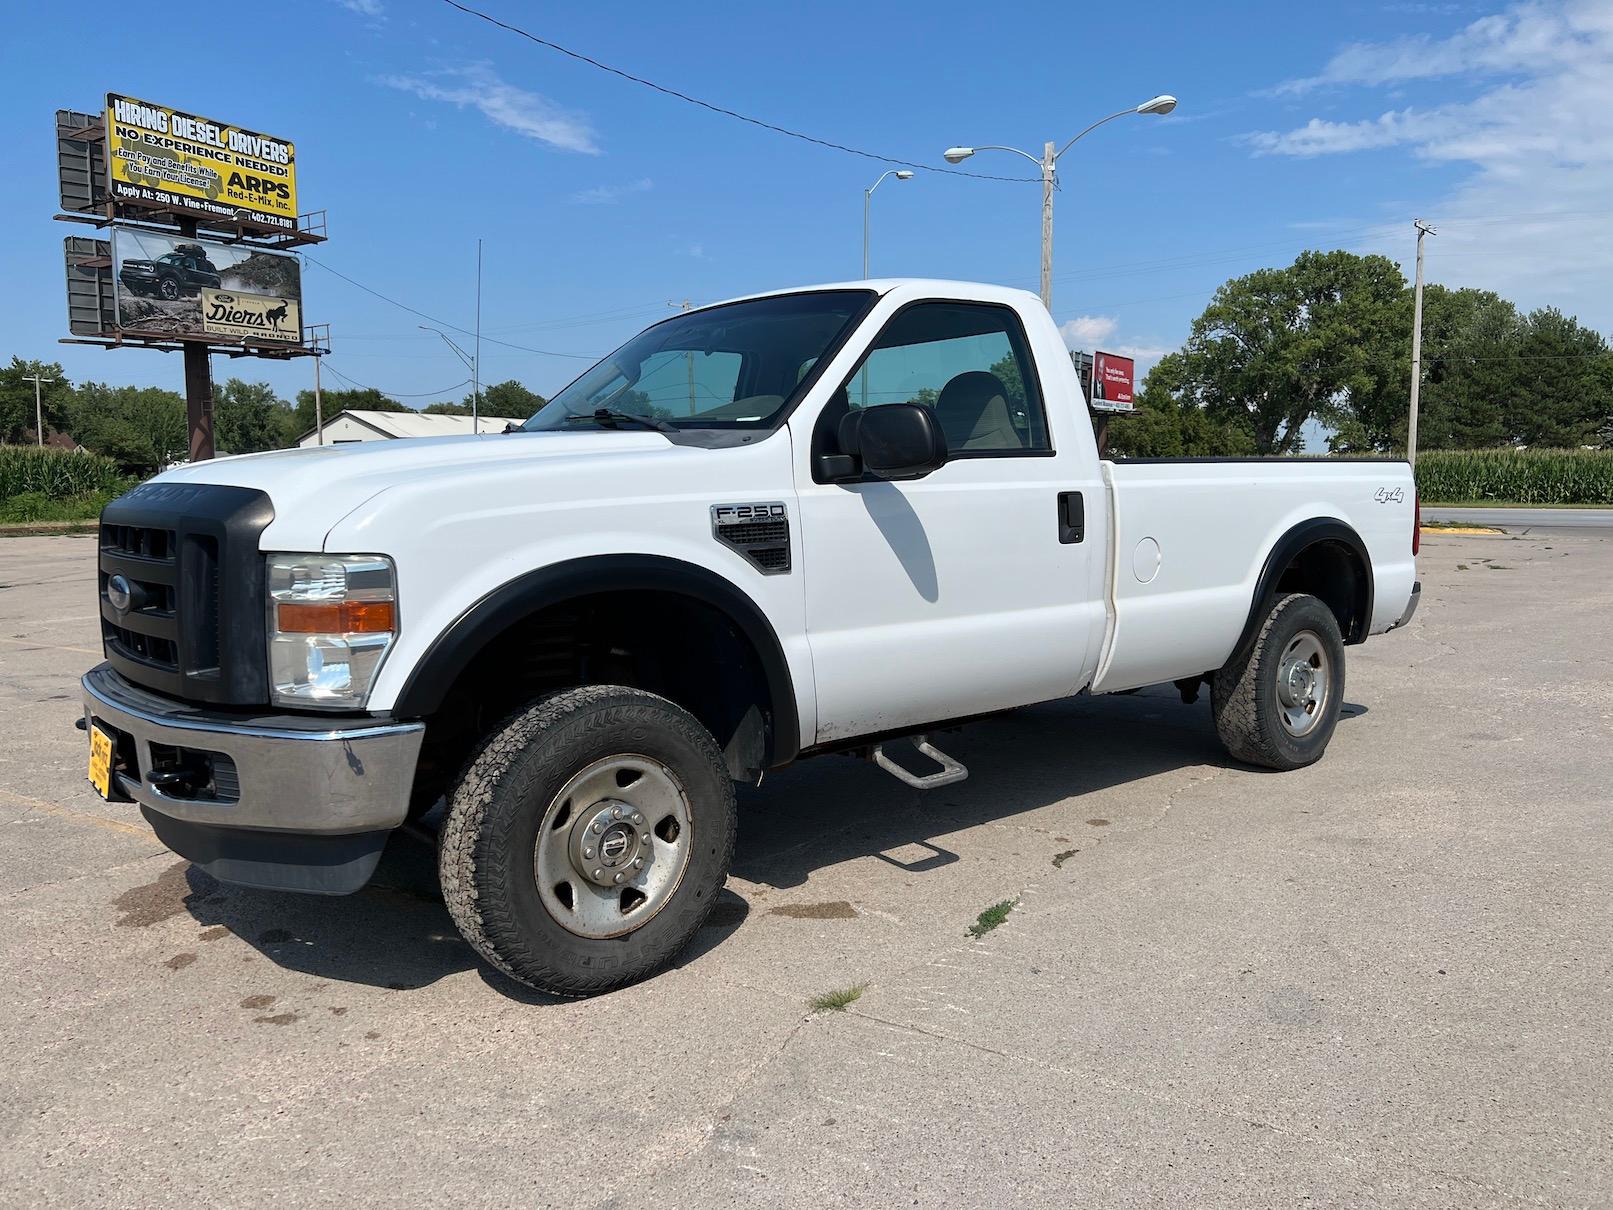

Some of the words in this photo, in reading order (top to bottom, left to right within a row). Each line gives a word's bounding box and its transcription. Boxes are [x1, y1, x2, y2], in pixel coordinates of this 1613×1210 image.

[114, 98, 168, 133] HIRING
[171, 114, 226, 149] DIESEL
[228, 129, 289, 165] DRIVERS
[115, 125, 139, 140] NO
[144, 133, 232, 163] EXPERIENCE
[235, 156, 288, 178] NEEDED!
[118, 147, 136, 159] Earn
[137, 152, 150, 164] Pay
[153, 157, 166, 167] and
[168, 160, 197, 174] Benefits
[199, 166, 217, 178] While
[129, 163, 142, 172] You
[144, 166, 160, 177] Earn
[162, 170, 179, 182] Your
[180, 174, 210, 188] License!
[227, 171, 290, 200] ARPS
[117, 184, 140, 198] Apply
[142, 189, 154, 199] At:
[156, 191, 171, 203] 250
[171, 195, 182, 206] W.
[227, 188, 274, 208] Red-E-Mix,
[275, 199, 291, 211] Inc.
[251, 212, 293, 229] 402.721.8181
[205, 302, 266, 326] Diers
[206, 325, 228, 333] BUILT
[1373, 487, 1404, 504] 4x4
[716, 505, 785, 519] F-250
